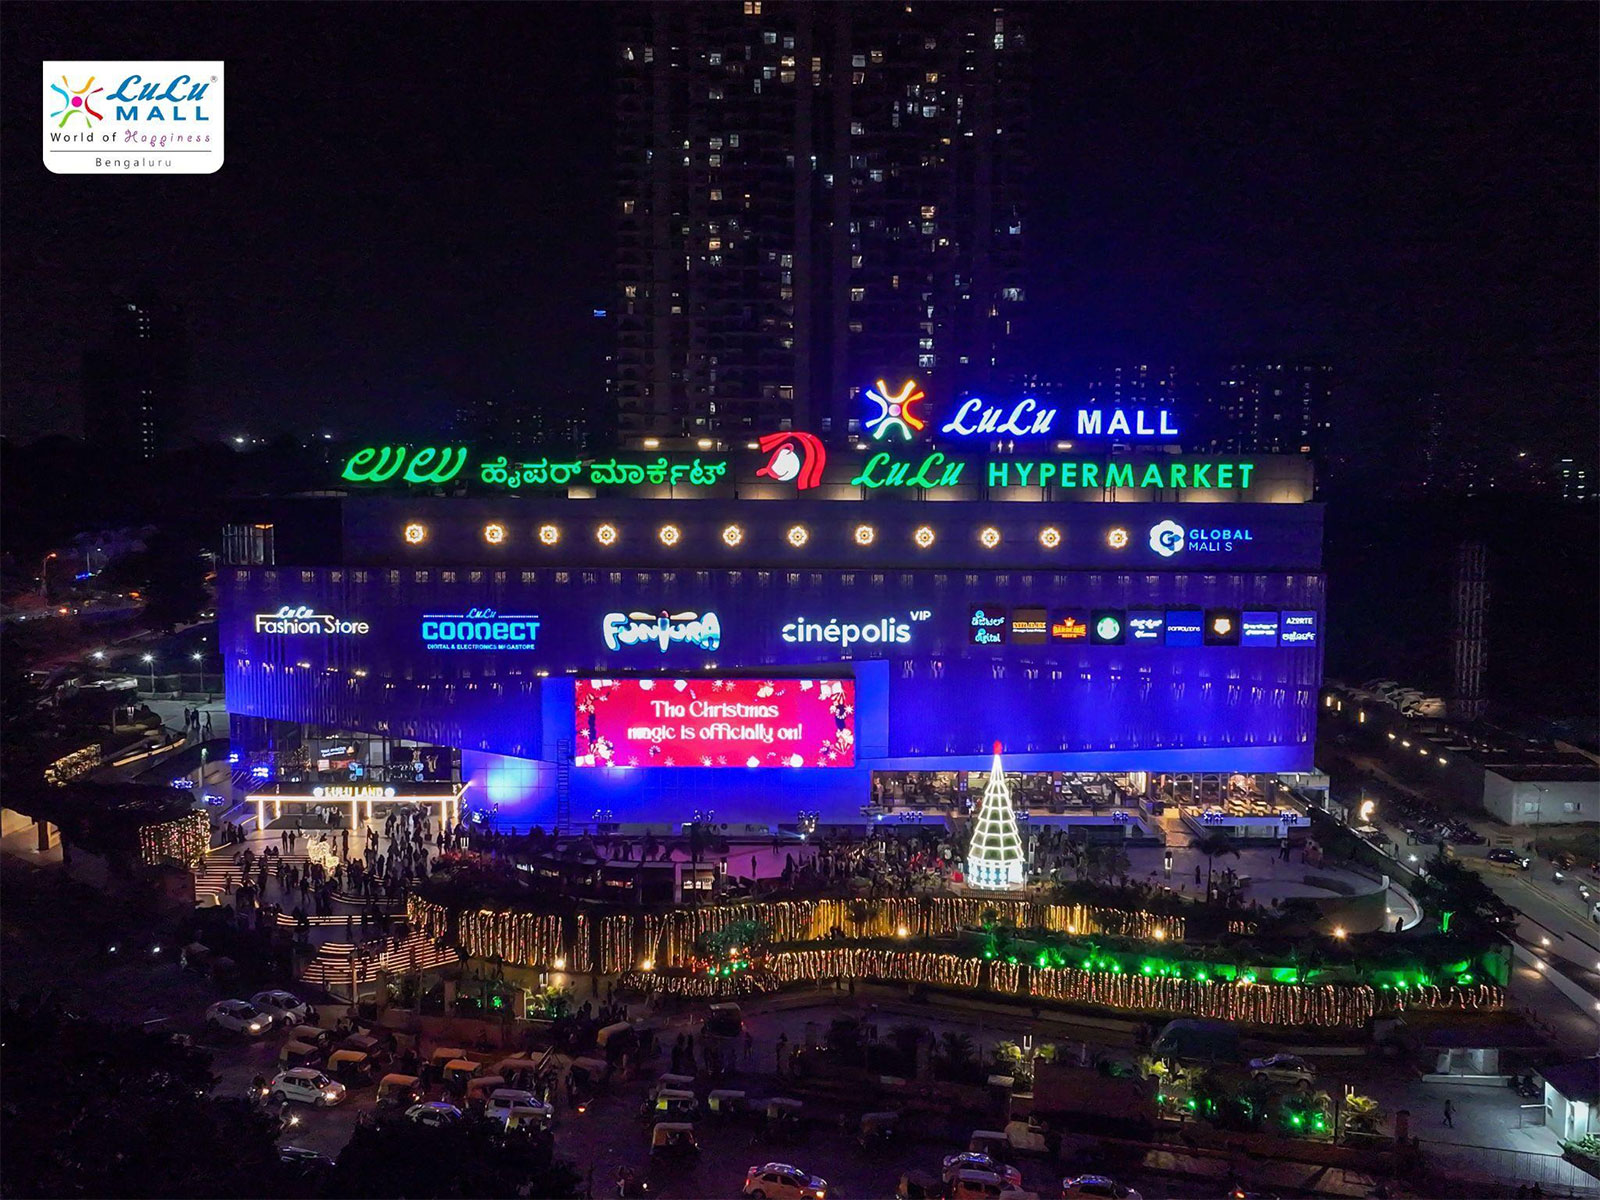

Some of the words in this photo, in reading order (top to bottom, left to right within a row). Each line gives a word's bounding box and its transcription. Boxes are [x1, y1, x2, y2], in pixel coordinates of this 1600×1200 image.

[941, 397, 1058, 436] LuLu
[1076, 409, 1179, 436] MALL
[850, 452, 966, 488] LuLu
[988, 462, 1255, 489] HYPERMARKET
[1188, 529, 1254, 541] GLOBAL
[255, 615, 320, 635] Fashion
[323, 615, 369, 635] Store
[782, 617, 911, 647] cinépolis
[910, 610, 932, 621] VIP
[689, 701, 779, 718] Christmas
[681, 724, 695, 741] is
[699, 722, 773, 743] officially
[777, 724, 803, 741] on!
